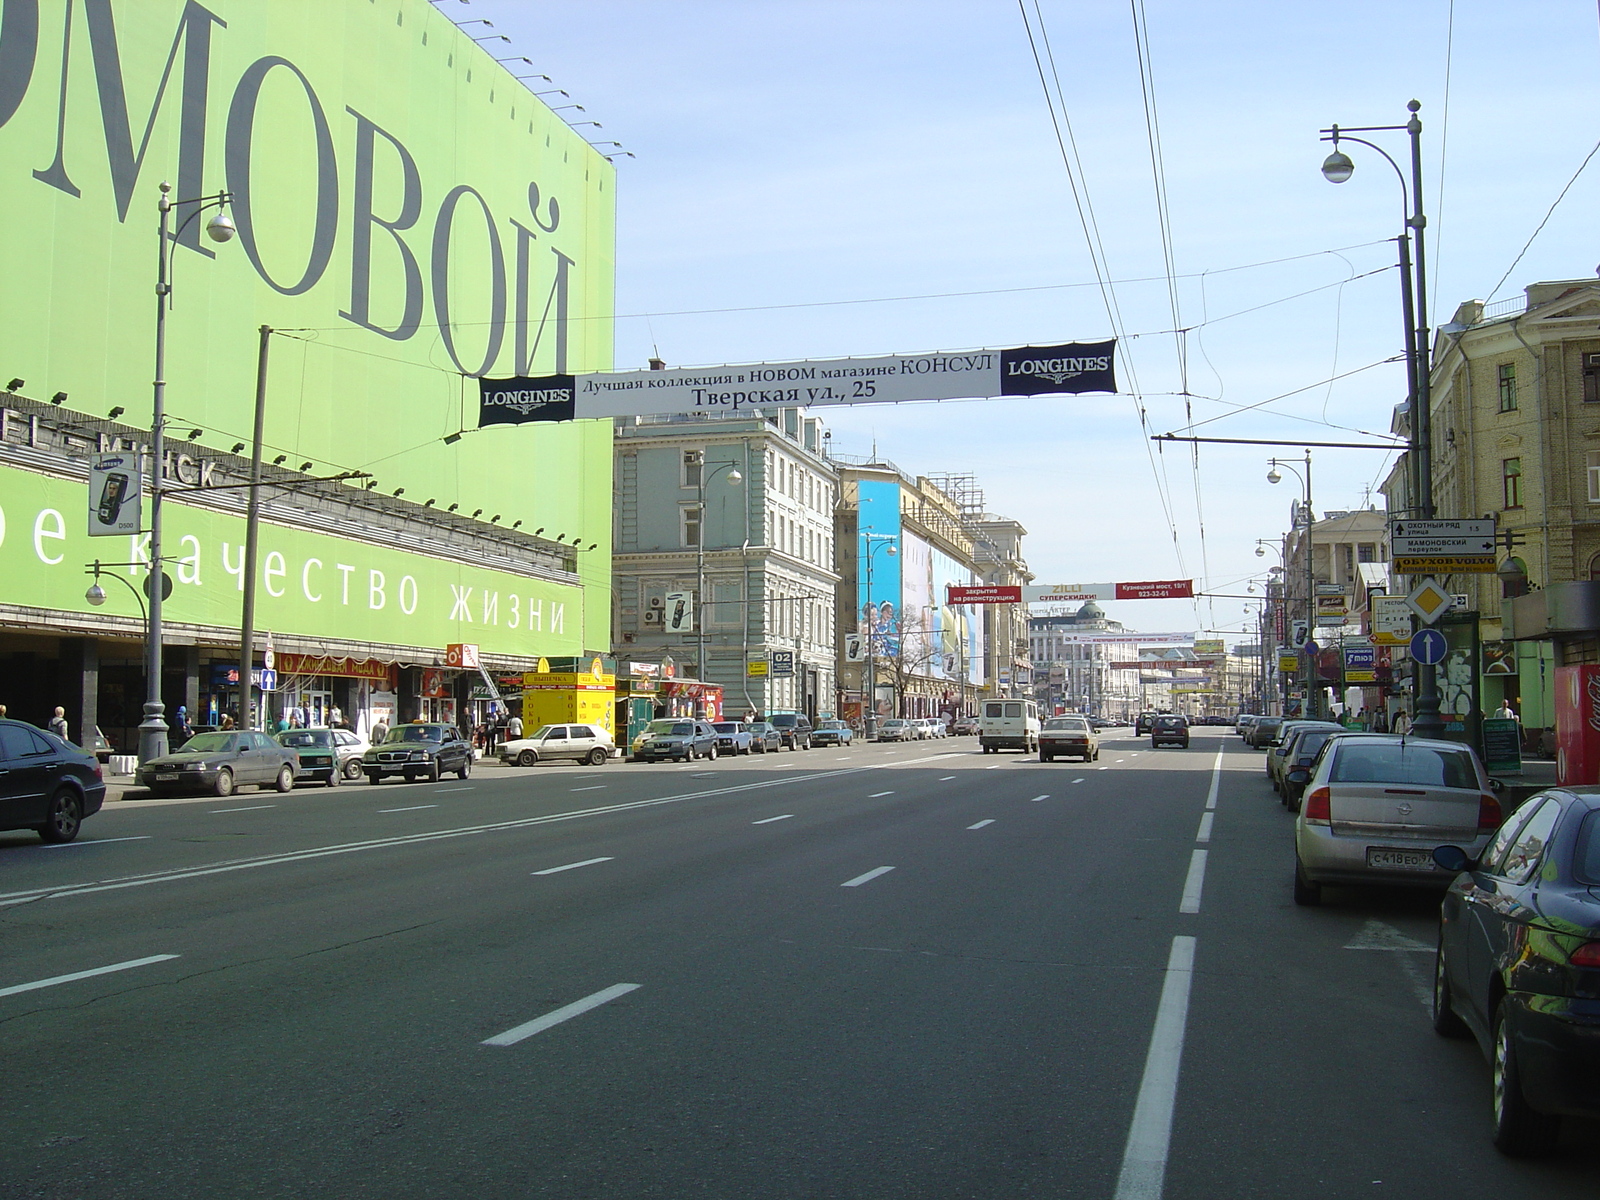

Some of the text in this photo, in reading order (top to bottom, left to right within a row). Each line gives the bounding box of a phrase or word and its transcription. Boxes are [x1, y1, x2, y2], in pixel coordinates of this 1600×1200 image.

[0, 0, 575, 378] МОВОЙ
[1008, 356, 1109, 376] LONGINES
[582, 354, 992, 396] Лучшая коллекция в НОВОМ магазине КОНСУЛ
[483, 387, 571, 406] LONGINES
[691, 380, 876, 409] Тверская ул., 25
[965, 588, 998, 596] закрытие
[1052, 584, 1082, 593] ZILLI
[1122, 583, 1155, 591] Кузнецкий
[962, 595, 1015, 603] реконструкцию
[775, 653, 791, 662] 02
